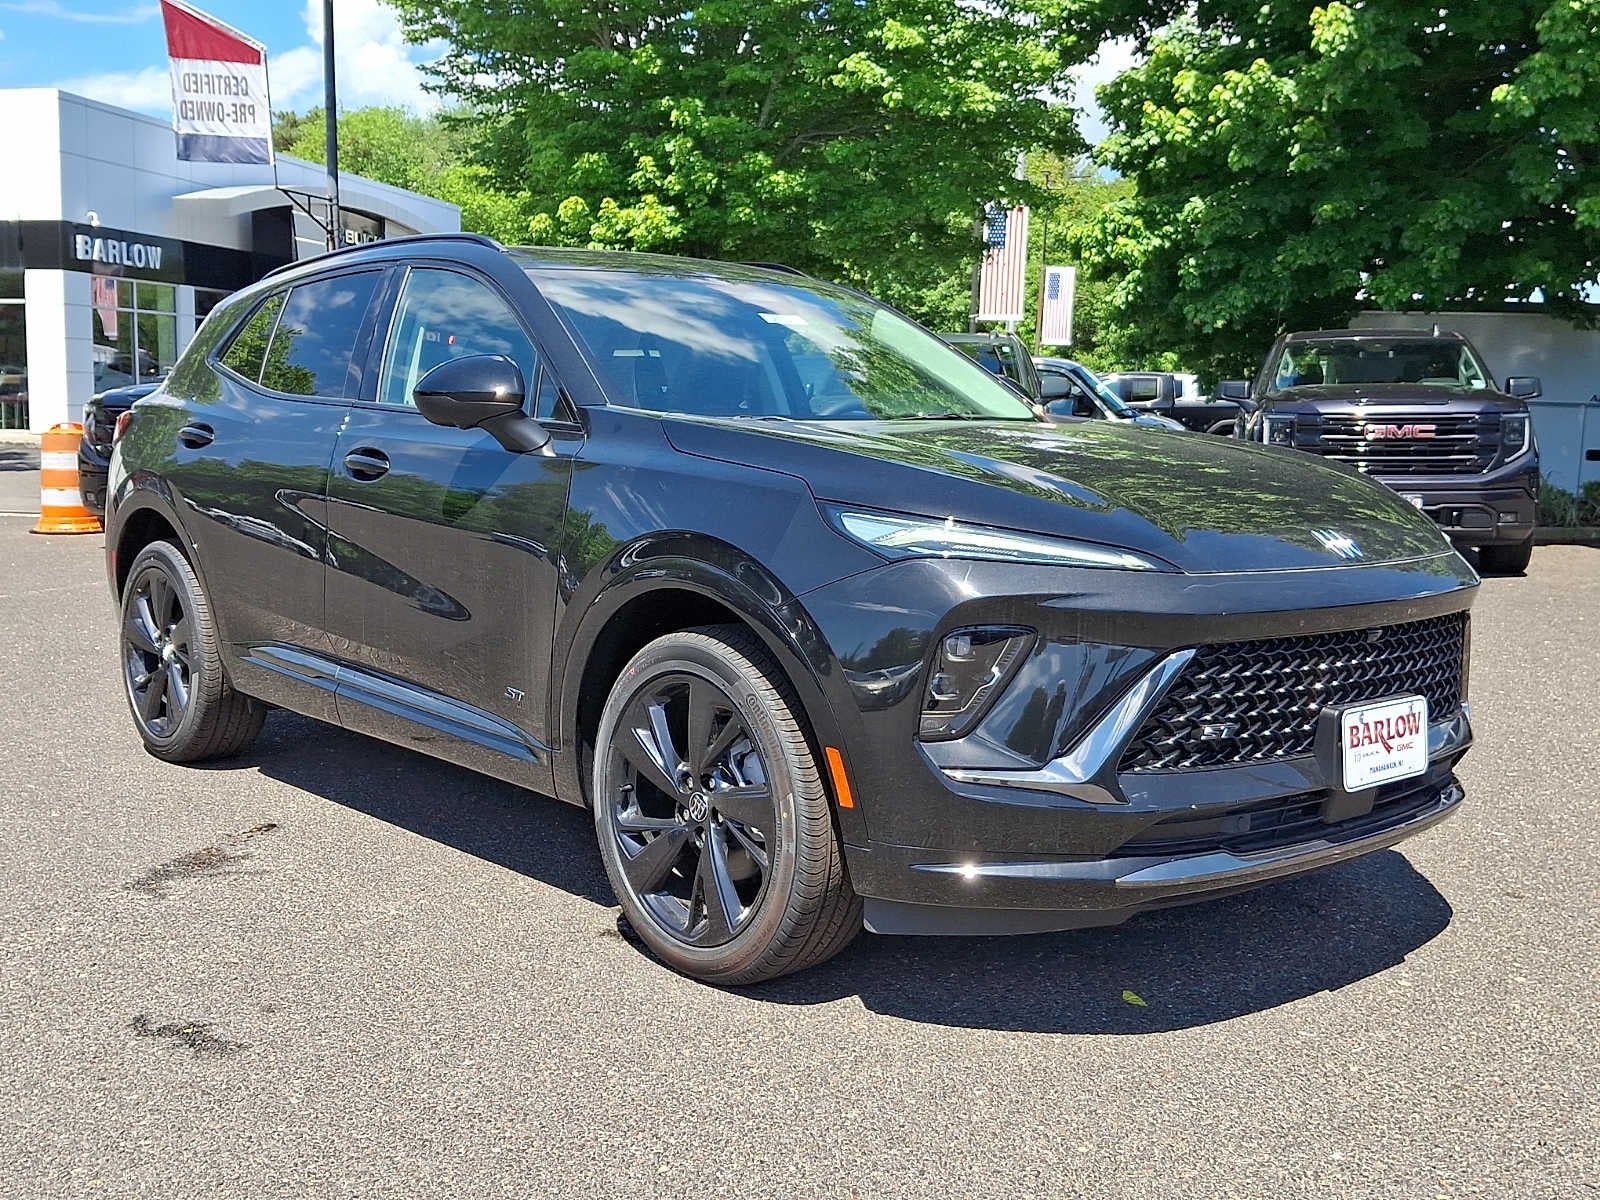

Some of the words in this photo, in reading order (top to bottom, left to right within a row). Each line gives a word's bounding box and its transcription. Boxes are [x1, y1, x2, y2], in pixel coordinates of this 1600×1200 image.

[75, 234, 162, 270] BARLOW
[1364, 424, 1436, 439] GMC
[504, 686, 525, 701] ST
[1349, 712, 1421, 754] BARLOW
